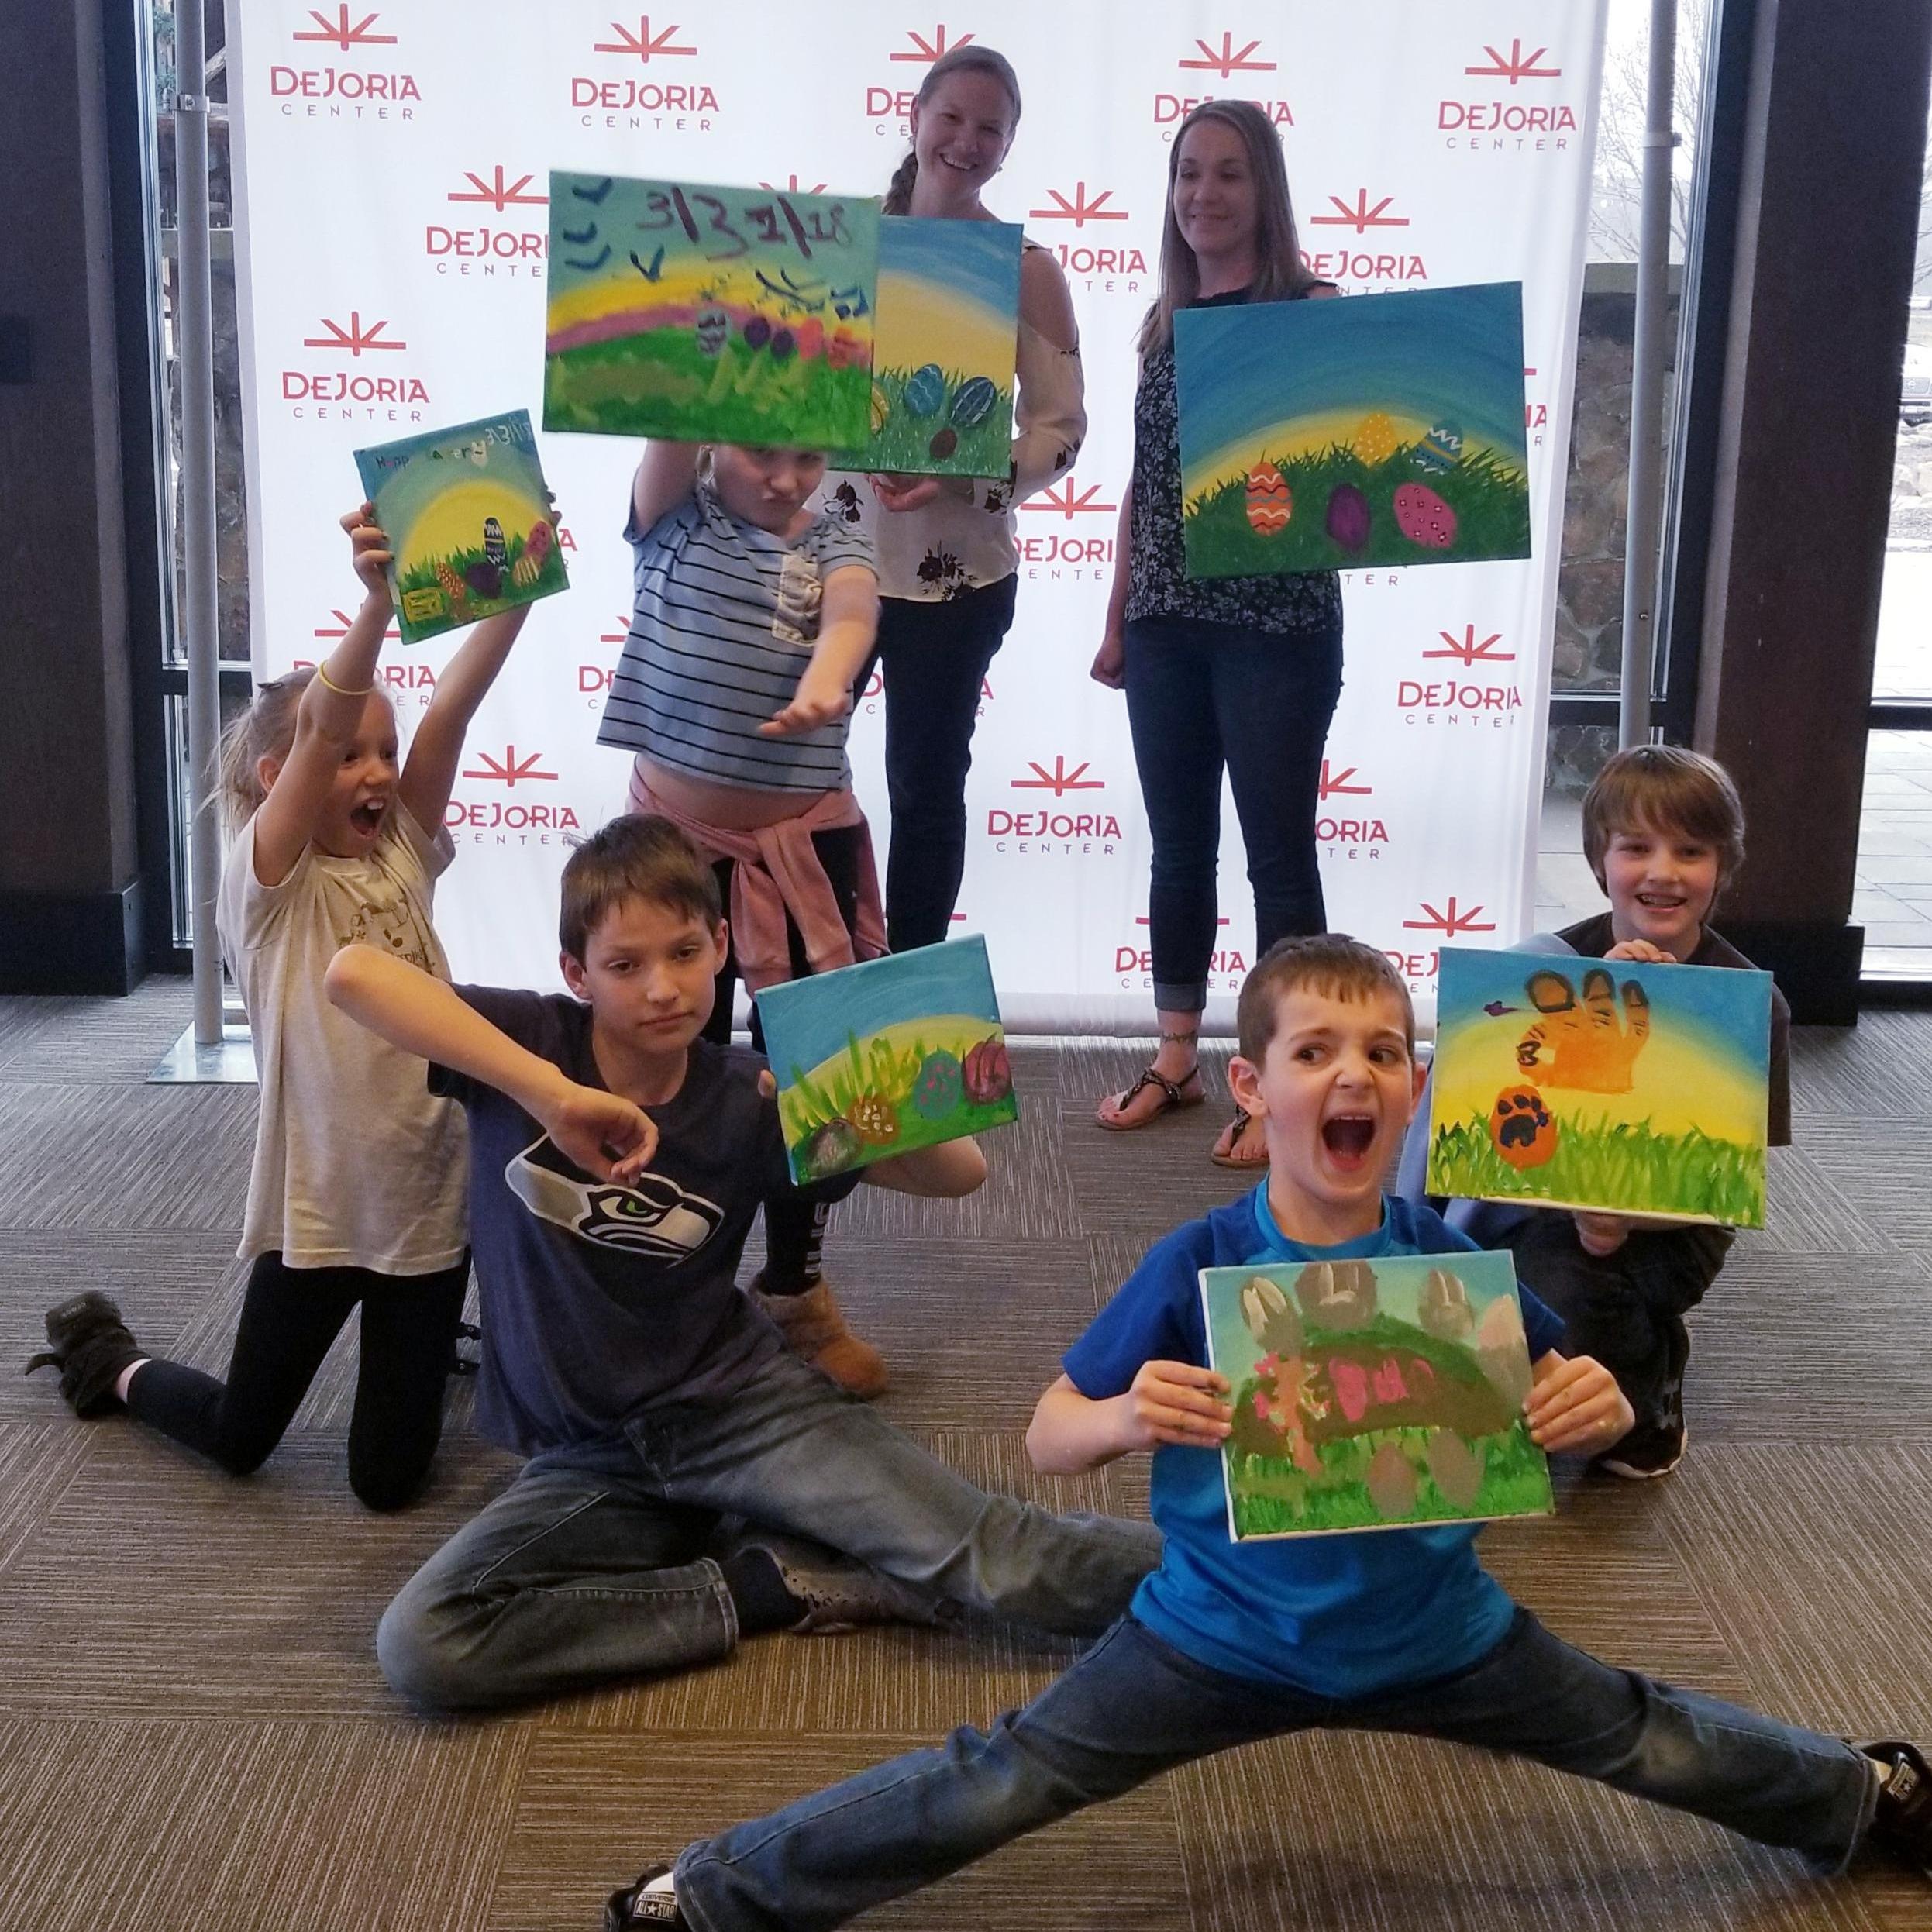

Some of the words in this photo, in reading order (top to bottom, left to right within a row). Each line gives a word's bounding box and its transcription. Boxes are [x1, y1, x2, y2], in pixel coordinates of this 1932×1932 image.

[270, 66, 422, 101] DEJORIA
[572, 78, 719, 112] DEJORIA
[281, 104, 412, 120] CENTER
[1439, 102, 1576, 132] DEJORIA
[581, 115, 711, 131] CENTER
[1446, 137, 1567, 150] CENTER
[426, 226, 548, 259] DEJORI
[1059, 244, 1147, 274] JORIA
[437, 263, 542, 277] CENTE
[1085, 281, 1138, 292] TER
[283, 372, 429, 403] DEJORIA
[294, 408, 421, 422] CENTER
[1014, 536, 1113, 563] EJORI
[1028, 569, 1103, 580] ENTE
[1345, 574, 1398, 585] TER
[988, 810, 1122, 839] DEJORIA
[1315, 818, 1389, 842] ORIA
[996, 842, 1114, 855] CENTER
[1328, 848, 1379, 859] TER
[636, 1901, 647, 1914] ALL
[657, 1903, 675, 1918] STAR
